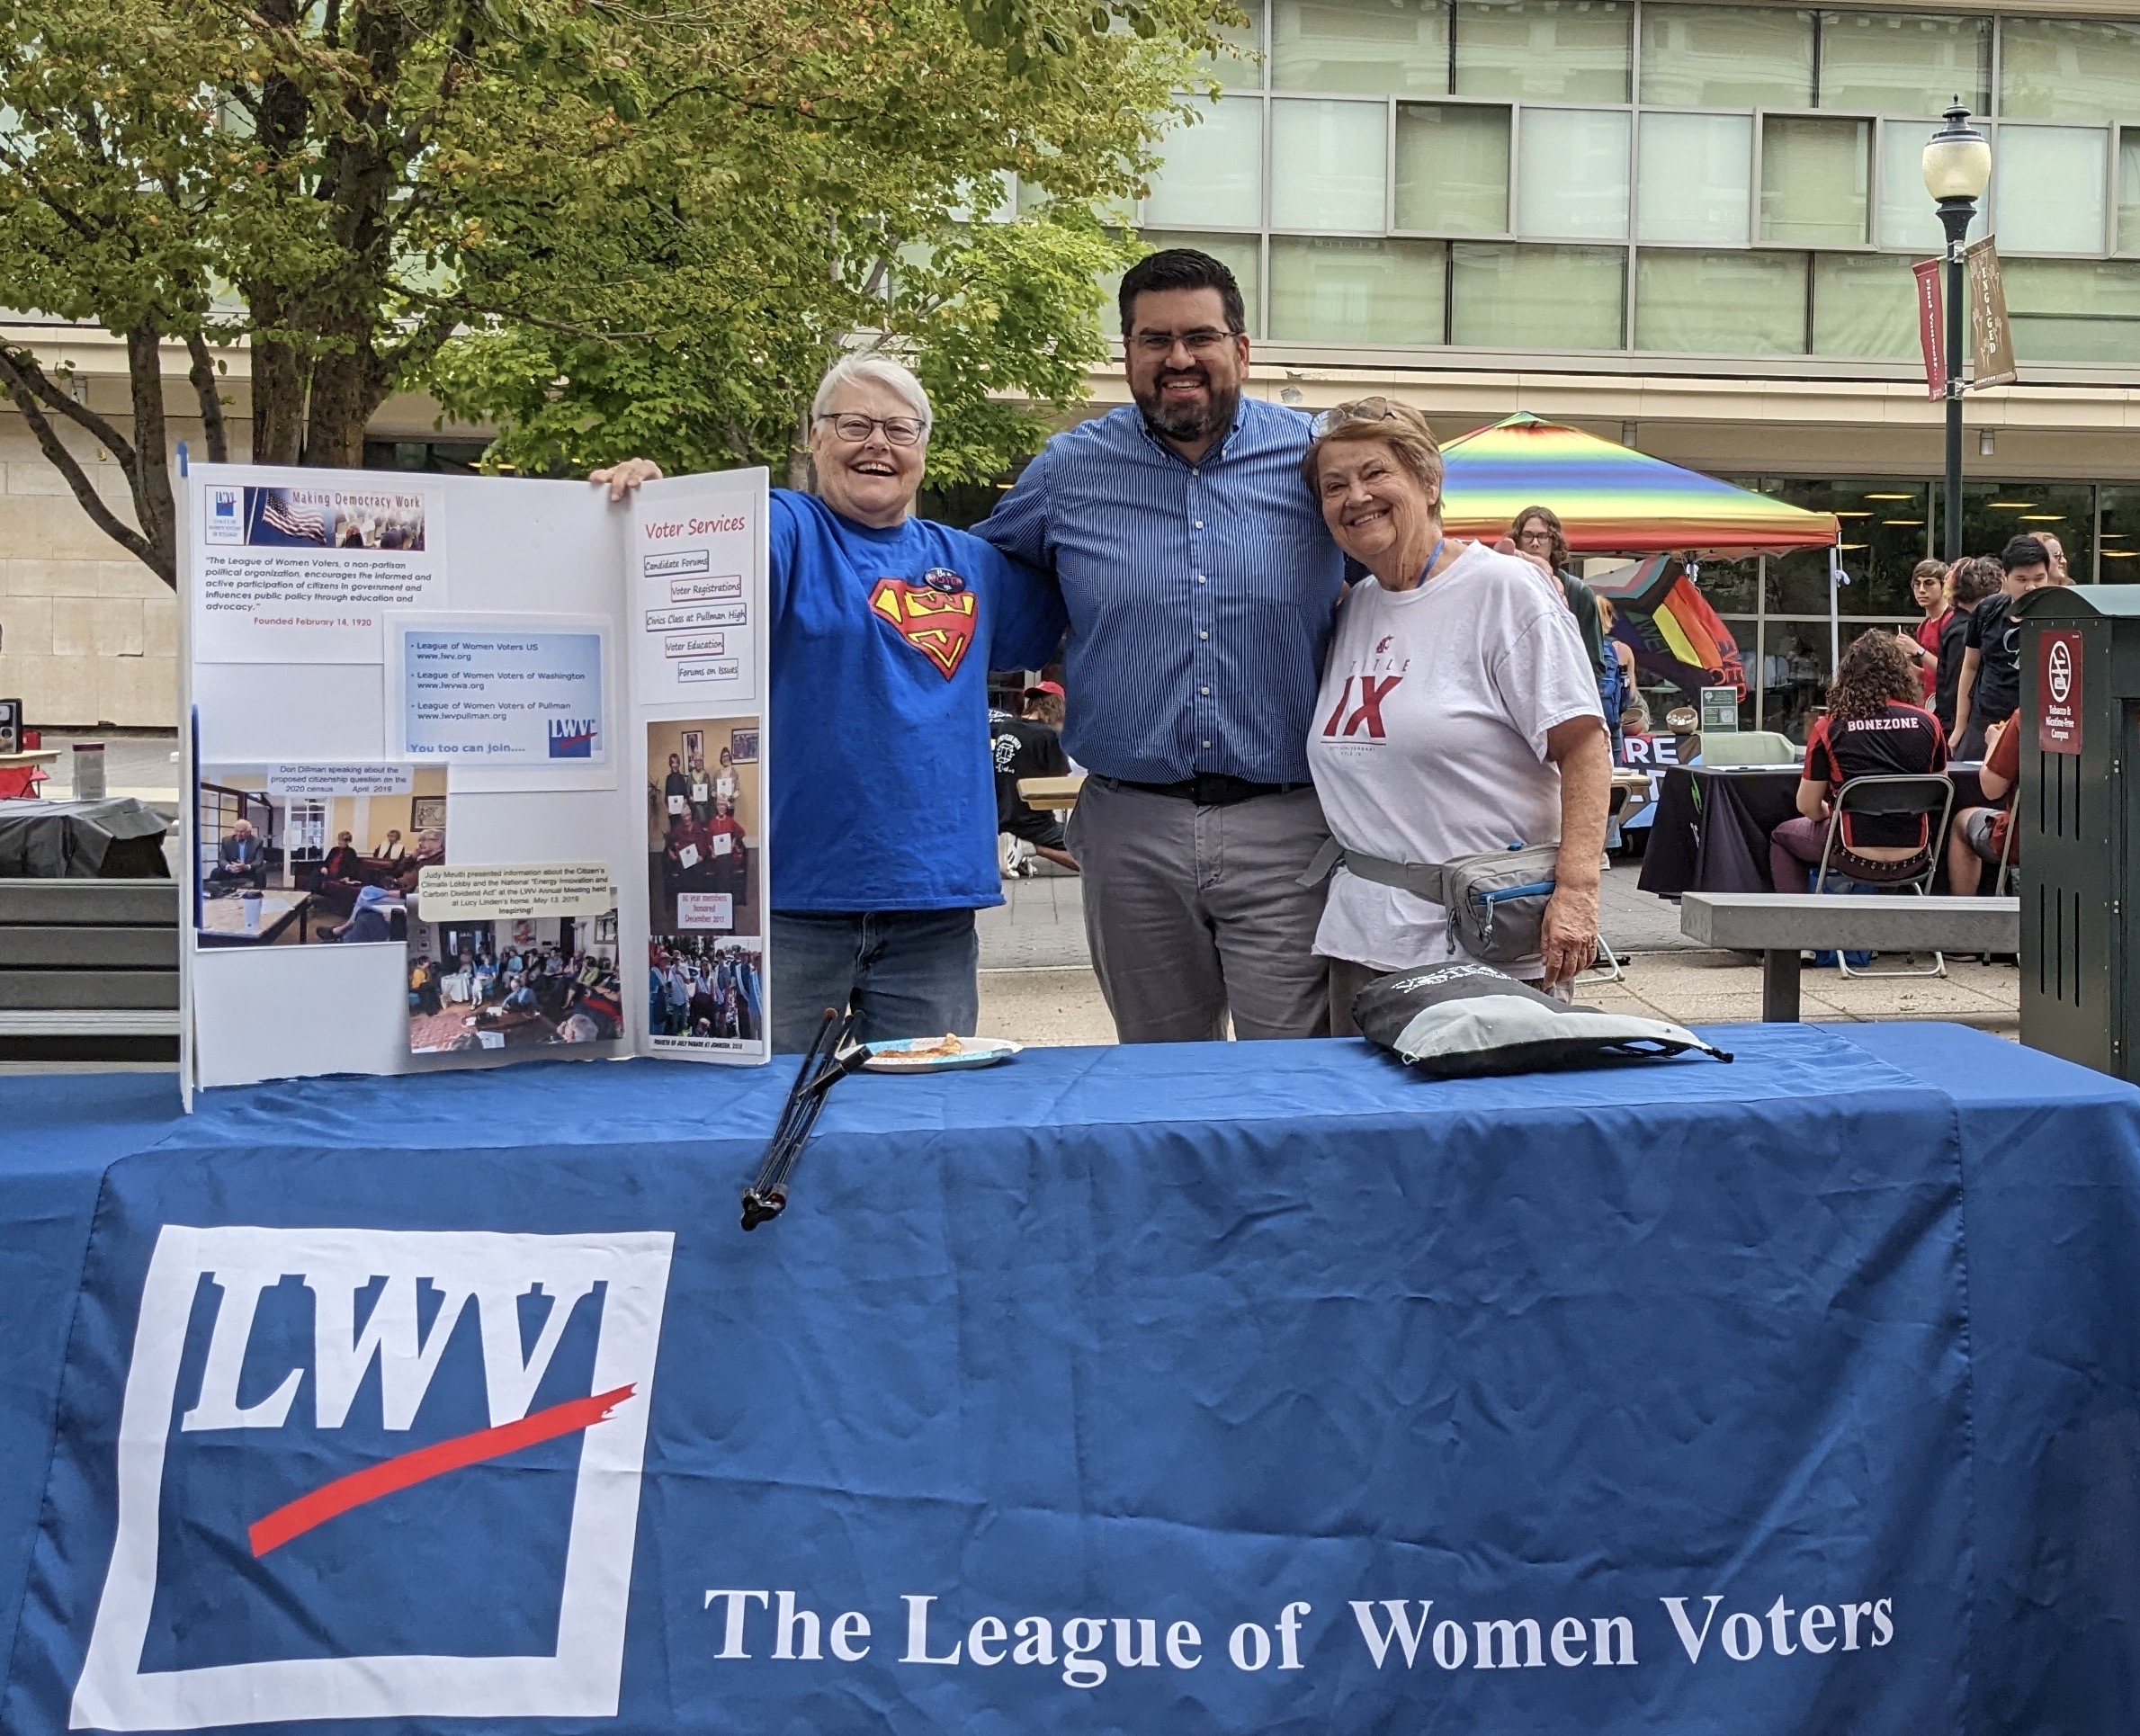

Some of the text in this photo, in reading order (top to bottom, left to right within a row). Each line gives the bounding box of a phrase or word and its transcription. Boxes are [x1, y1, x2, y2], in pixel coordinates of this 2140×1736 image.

[1982, 267, 1996, 354] ENGAGED
[291, 491, 420, 508] Making Democracy Work
[646, 515, 745, 539] Voter Services
[228, 558, 262, 567] League
[645, 558, 708, 571] Candidate Forums
[206, 568, 242, 577] political
[305, 572, 356, 580] encourages
[375, 572, 413, 580] informed
[237, 581, 293, 589] participation
[672, 586, 691, 595] Voter
[206, 591, 251, 599] influences
[255, 592, 282, 600] public
[285, 593, 312, 601] policy
[315, 594, 347, 603] through
[296, 618, 334, 626] February
[647, 616, 666, 625] Civics
[667, 614, 685, 623] Class
[696, 612, 726, 622] Pullman
[729, 610, 745, 622] High
[417, 642, 448, 650] League
[667, 640, 723, 651] Voter Education
[416, 653, 471, 661] www.lwv.org
[1351, 659, 1410, 671] TITLE
[417, 672, 448, 680] League
[538, 673, 585, 681] Washington
[679, 668, 704, 676] Forums
[719, 667, 738, 675] Issues
[417, 682, 484, 690] www.lwvwa.org
[417, 702, 449, 711] League
[1323, 676, 1403, 738] IX
[2049, 705, 2066, 715] Tobacco
[417, 712, 506, 720] www.lwvpullman.org
[550, 720, 591, 738] LWV
[1848, 718, 1919, 731] BONEZONE
[2052, 729, 2068, 741] Campus
[409, 744, 434, 753] You
[328, 766, 362, 774] speaking
[180, 1271, 595, 1431] LWV
[703, 1589, 1894, 1688] The League of Women Voters
